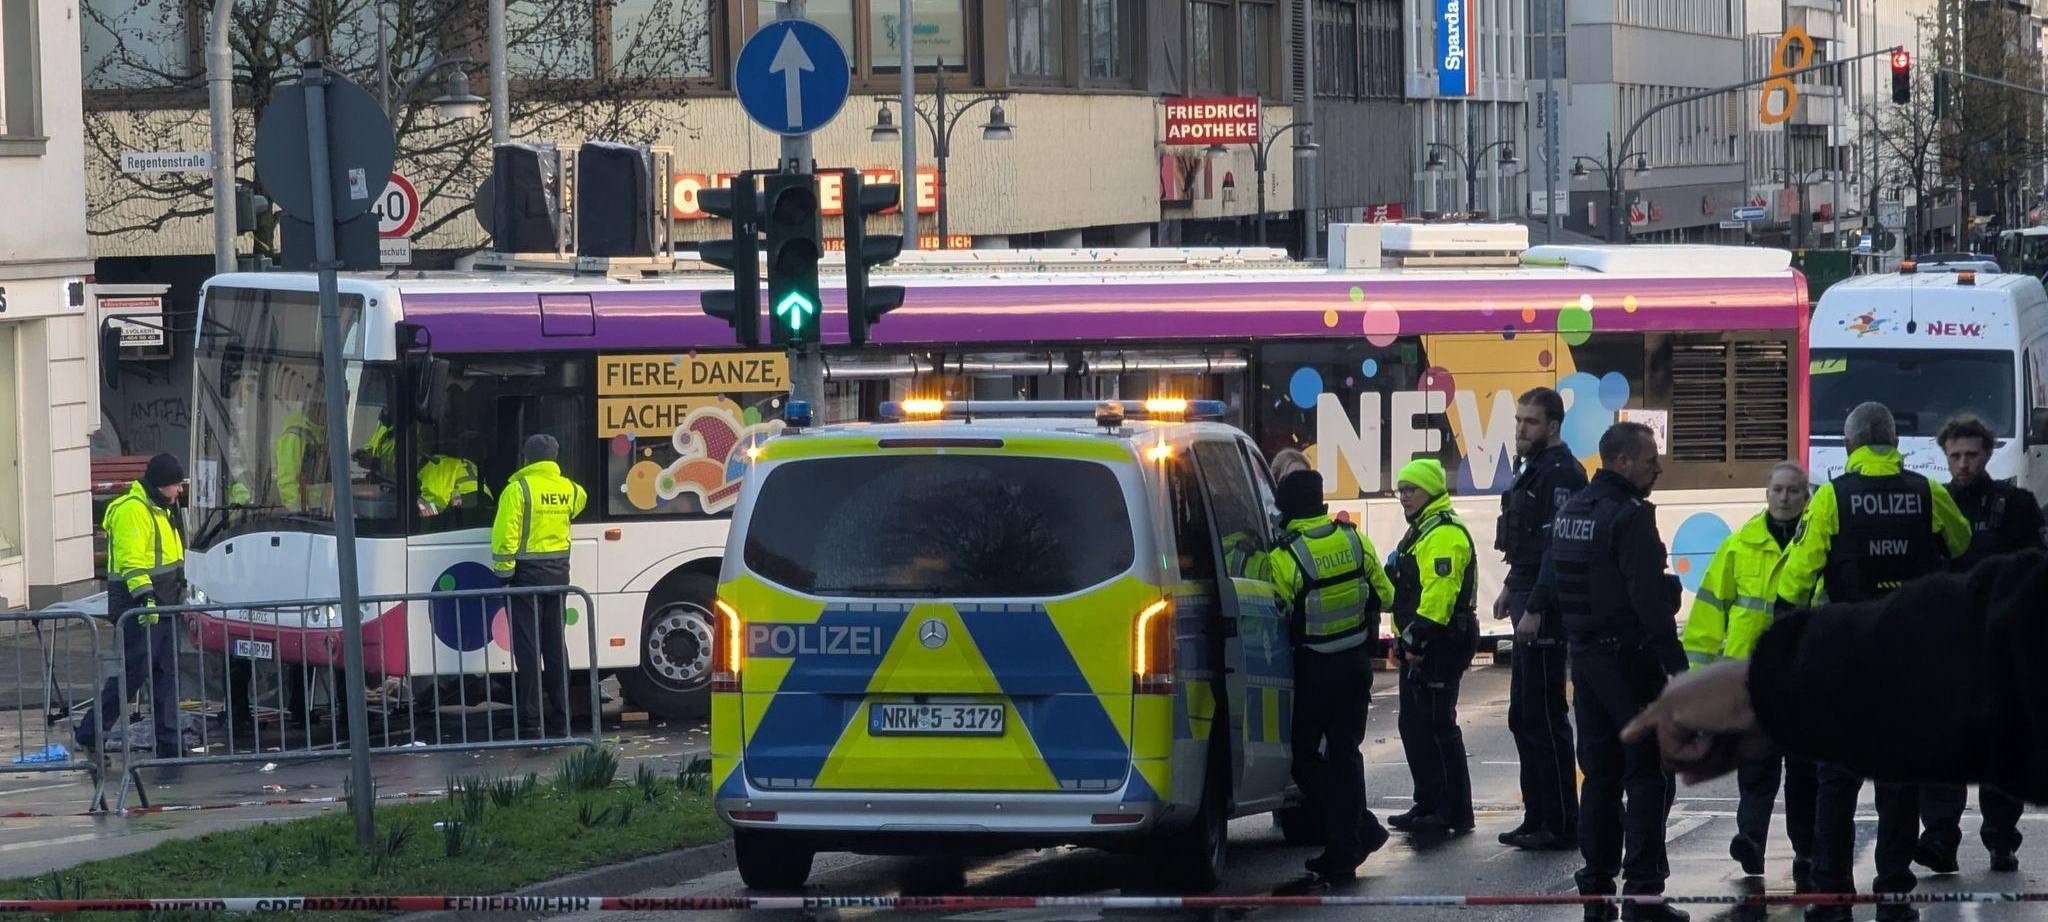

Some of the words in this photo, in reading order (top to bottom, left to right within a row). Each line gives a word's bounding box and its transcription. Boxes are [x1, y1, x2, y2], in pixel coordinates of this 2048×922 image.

[1445, 0, 1464, 70] Sparda
[1167, 104, 1257, 120] FRIEDRICH
[1168, 123, 1257, 138] APOTHEKE
[127, 155, 206, 171] Regentenstraße
[1928, 321, 1981, 338] NEW
[606, 363, 684, 390] FIERE,
[691, 360, 782, 388] DANZE,
[606, 404, 688, 430] LACHE
[1316, 388, 1575, 493] NEW
[540, 493, 571, 505] NEW
[1851, 493, 1922, 515] POLIZEI
[1553, 517, 1596, 540] POLIZEI
[1869, 540, 1908, 556] NRW
[239, 609, 268, 623] SOARIS
[751, 626, 881, 655] POLIZEI
[882, 706, 919, 730] NRW
[931, 706, 1002, 730] 5-3179
